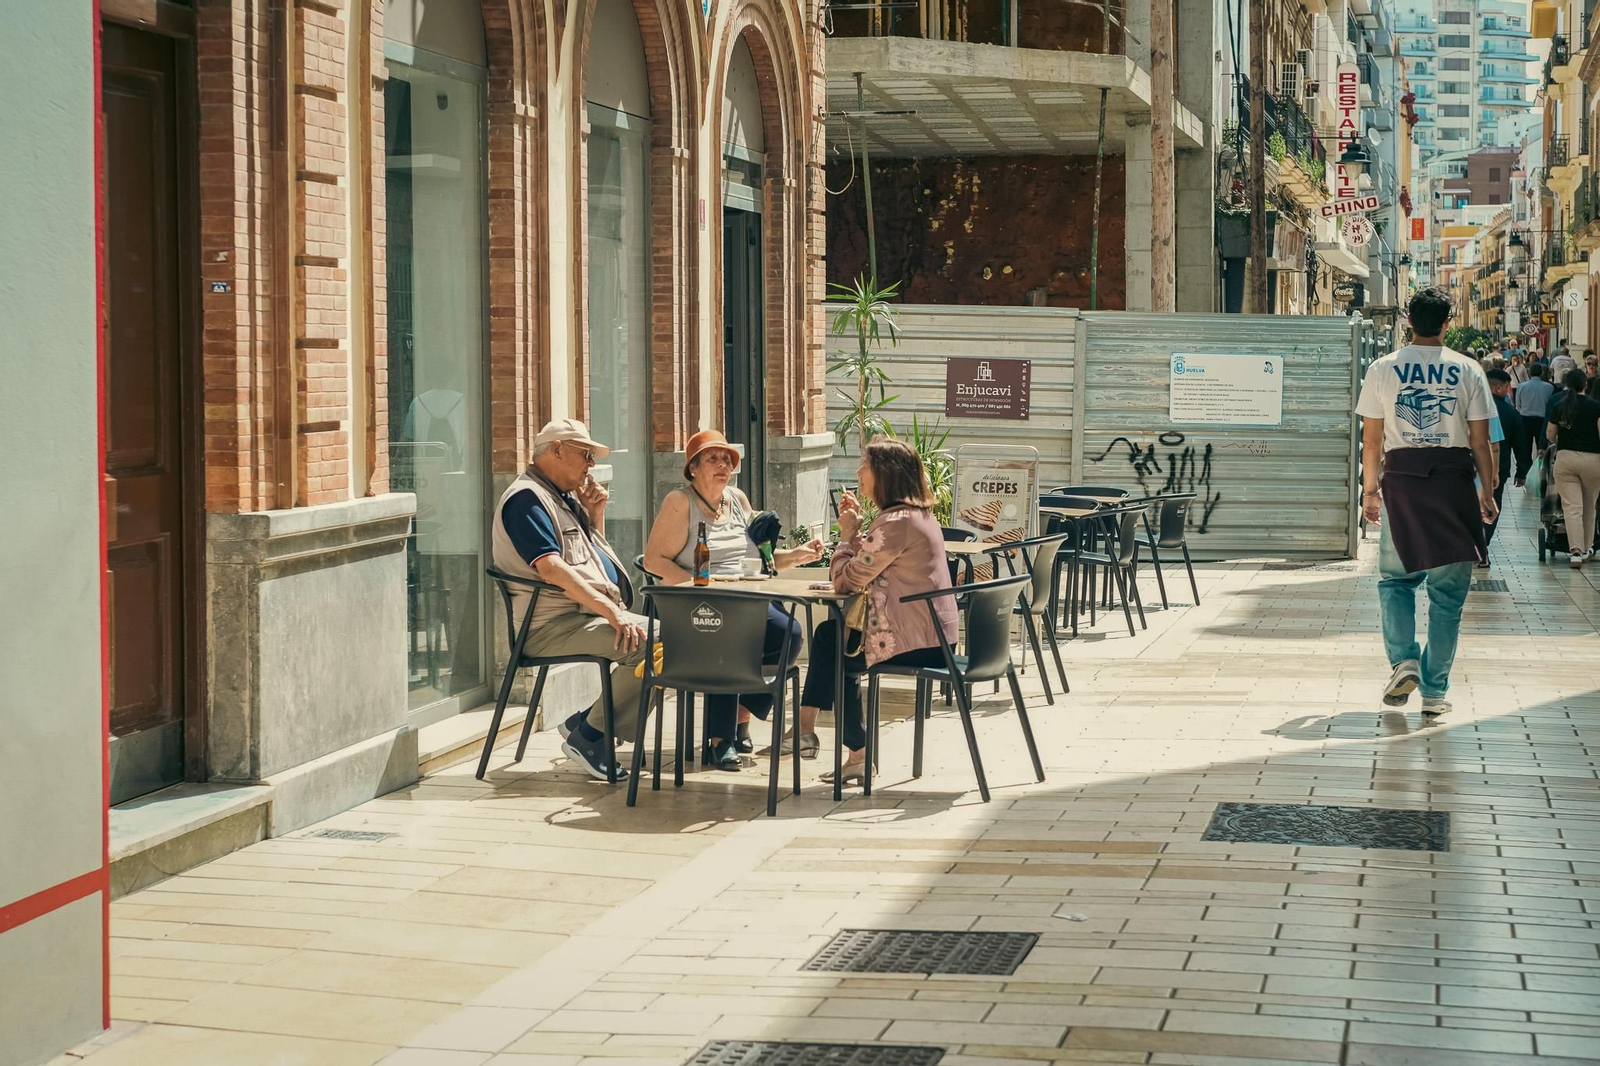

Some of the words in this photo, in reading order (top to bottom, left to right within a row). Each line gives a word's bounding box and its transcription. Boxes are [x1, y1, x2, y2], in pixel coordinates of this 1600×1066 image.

[1321, 197, 1378, 217] CHINO
[1393, 363, 1460, 386] VANS
[956, 383, 1012, 398] Enjucavi
[972, 481, 1018, 494] CREPES
[693, 617, 721, 626] BARCO
